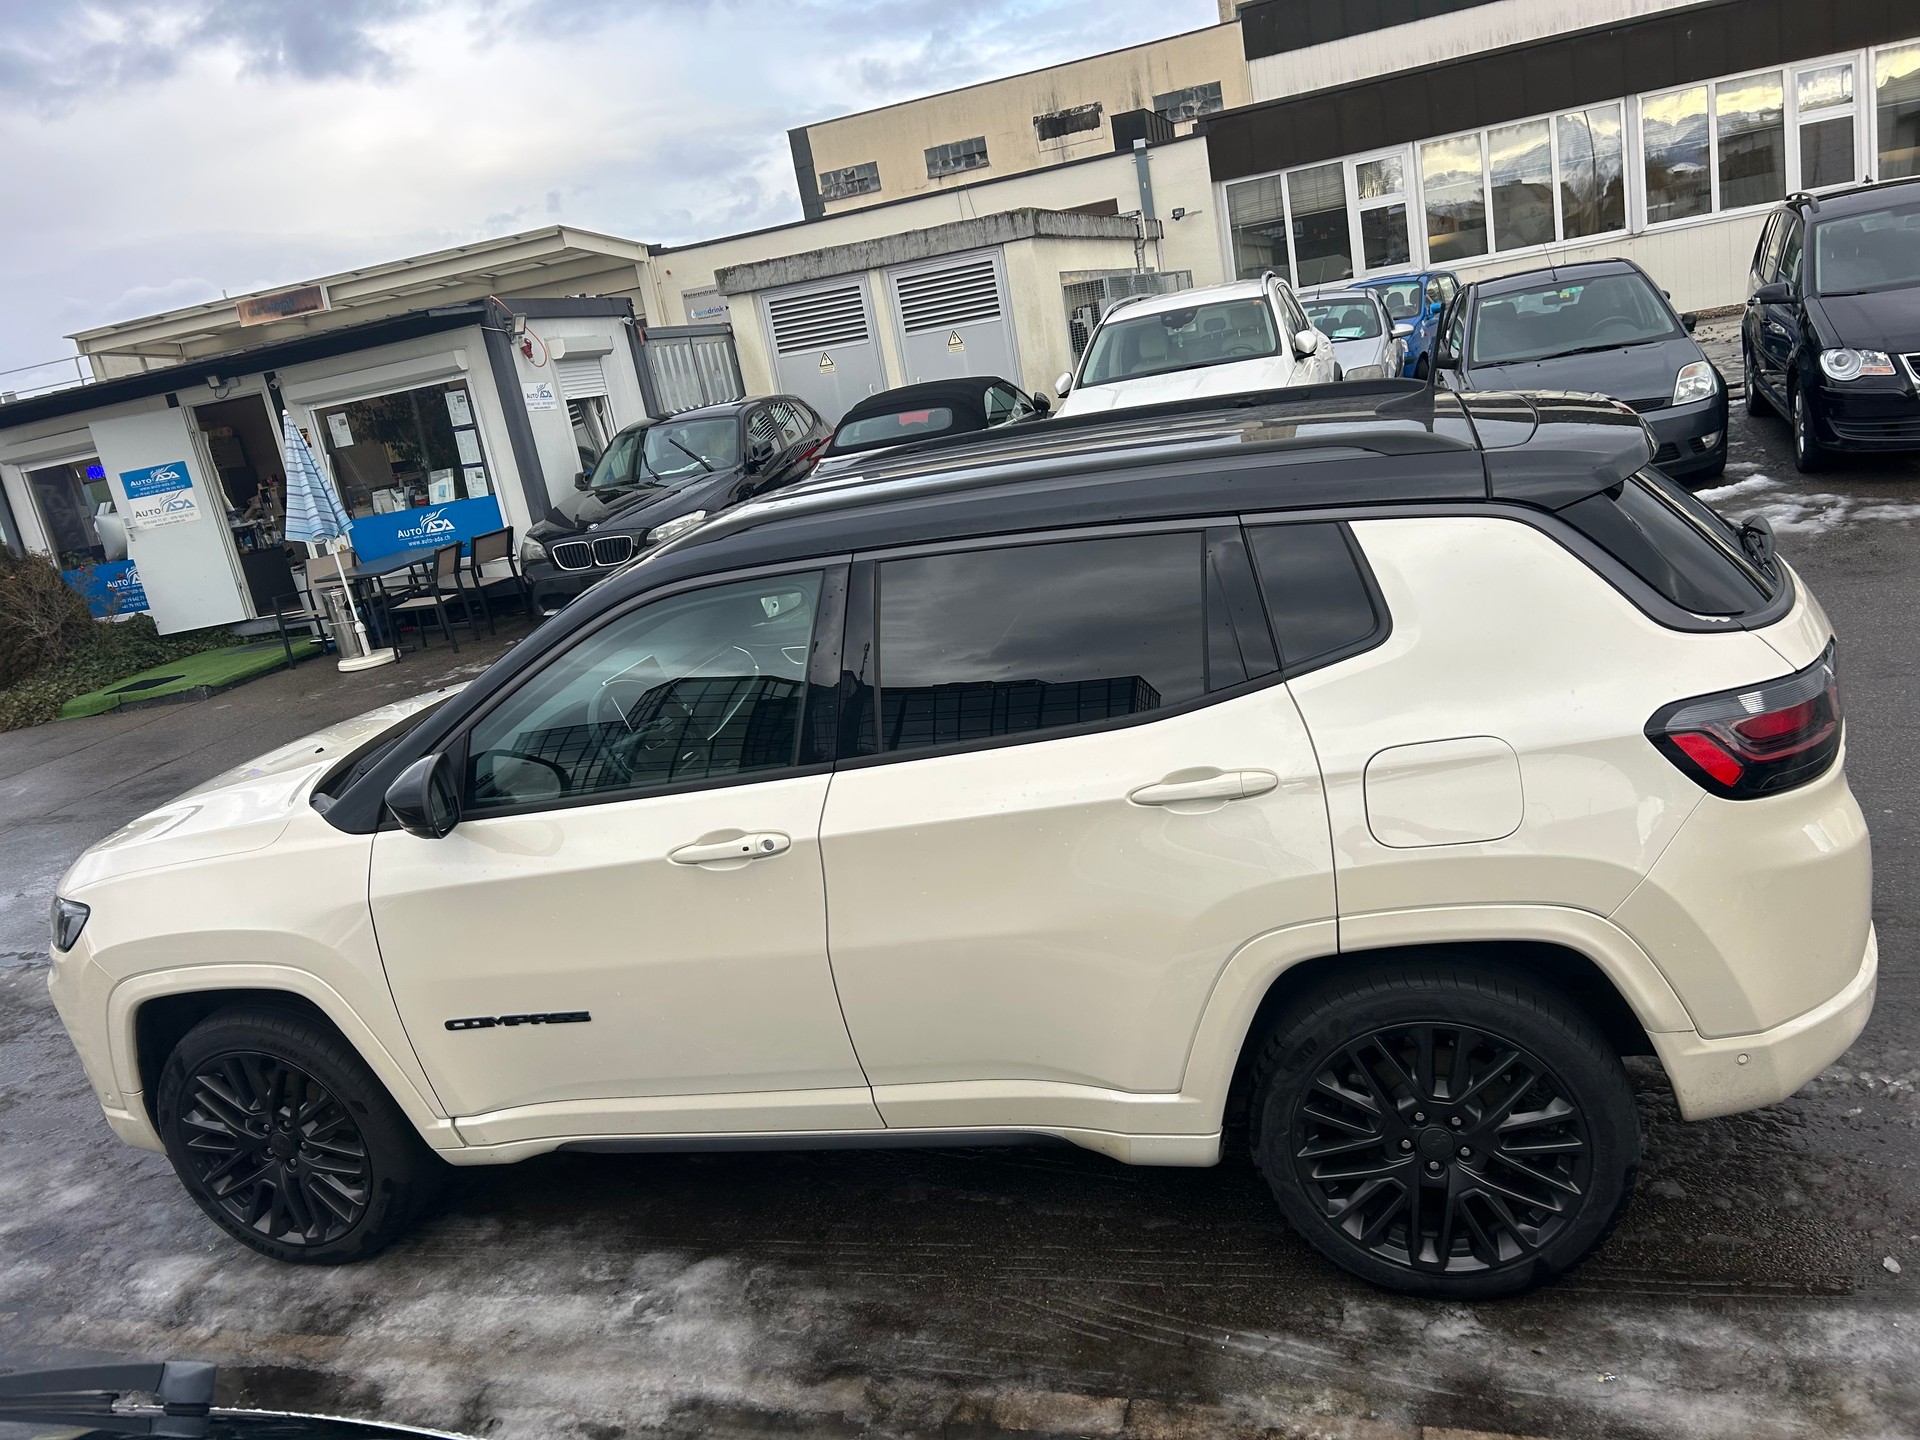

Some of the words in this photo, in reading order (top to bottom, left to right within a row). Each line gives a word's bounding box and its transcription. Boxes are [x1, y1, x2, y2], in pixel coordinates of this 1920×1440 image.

[130, 478, 152, 487] AUTO
[155, 471, 180, 482] ADA
[135, 508, 161, 519] AUTO
[166, 499, 196, 513] ADA
[397, 527, 422, 539] AUTO
[426, 518, 456, 534] ADA
[107, 578, 129, 588] AUTO
